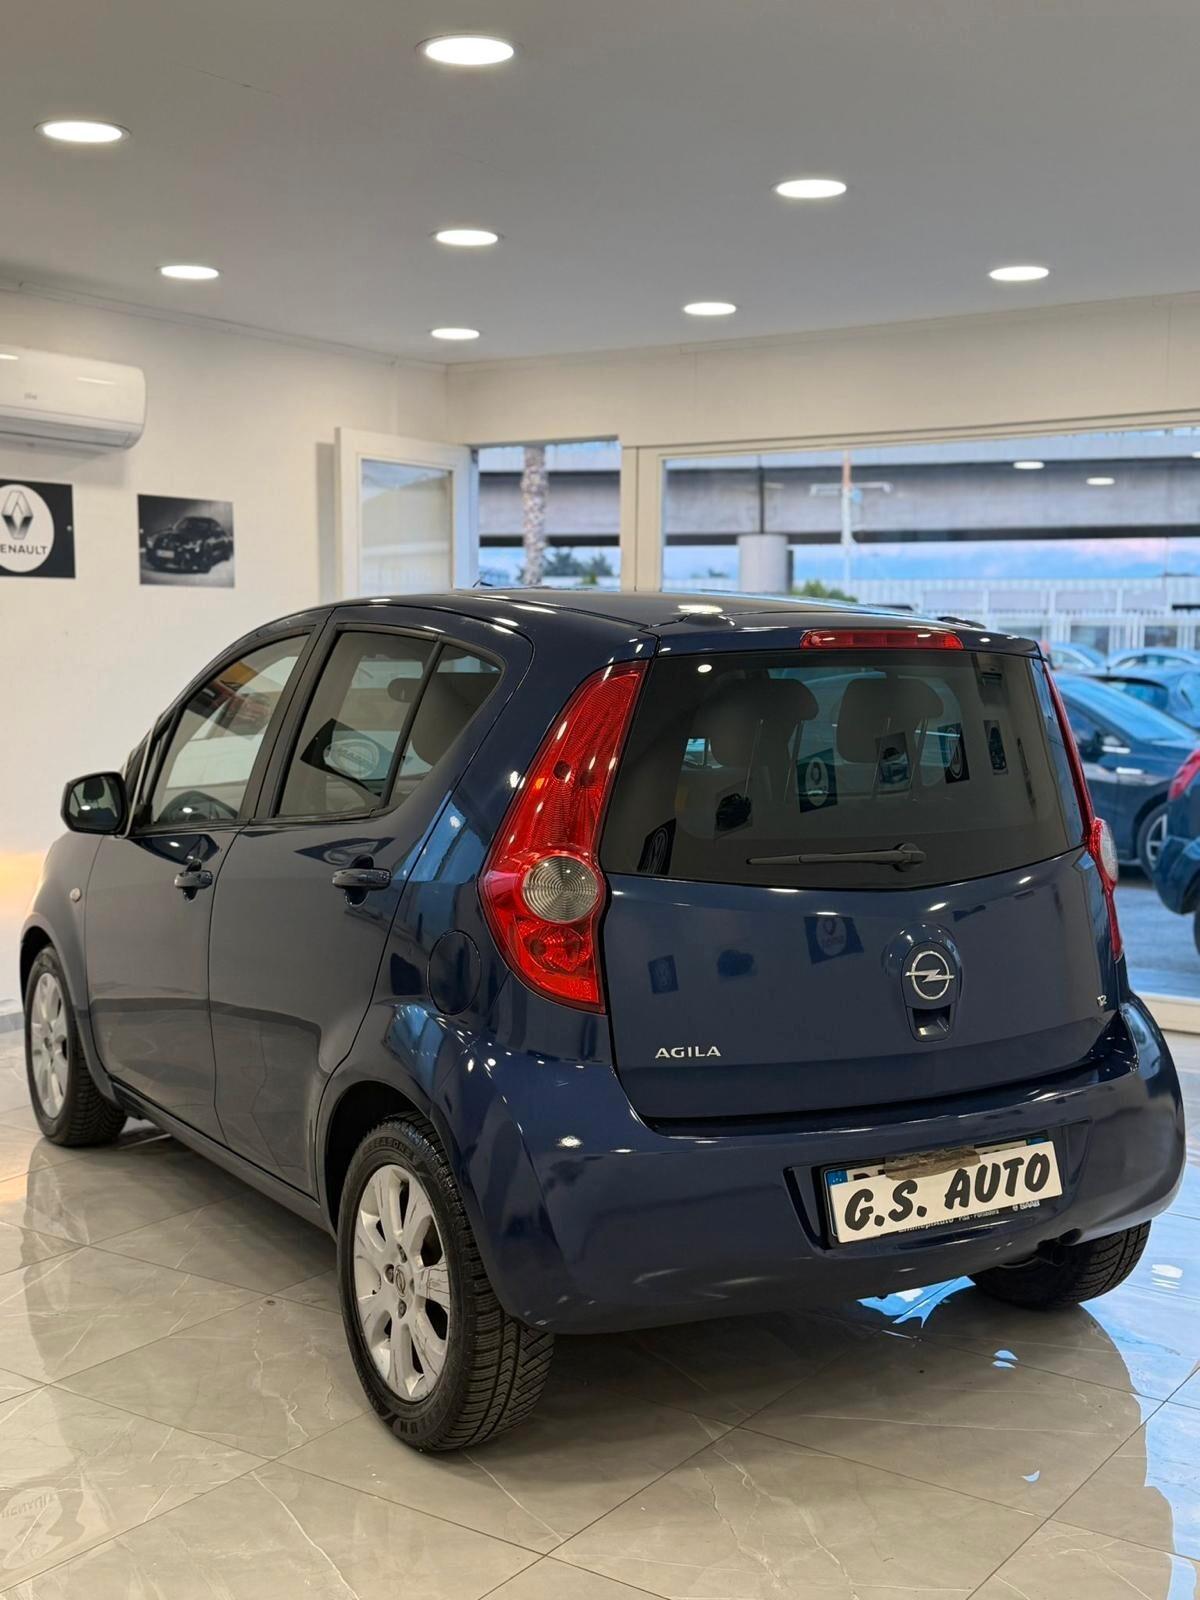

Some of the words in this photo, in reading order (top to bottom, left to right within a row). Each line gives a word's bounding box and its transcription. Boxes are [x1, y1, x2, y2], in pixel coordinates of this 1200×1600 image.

[0, 544, 48, 555] ENAULT
[655, 1045, 722, 1059] AGILA
[844, 1180, 928, 1231] G.S.
[944, 1152, 1050, 1210] AUTO
